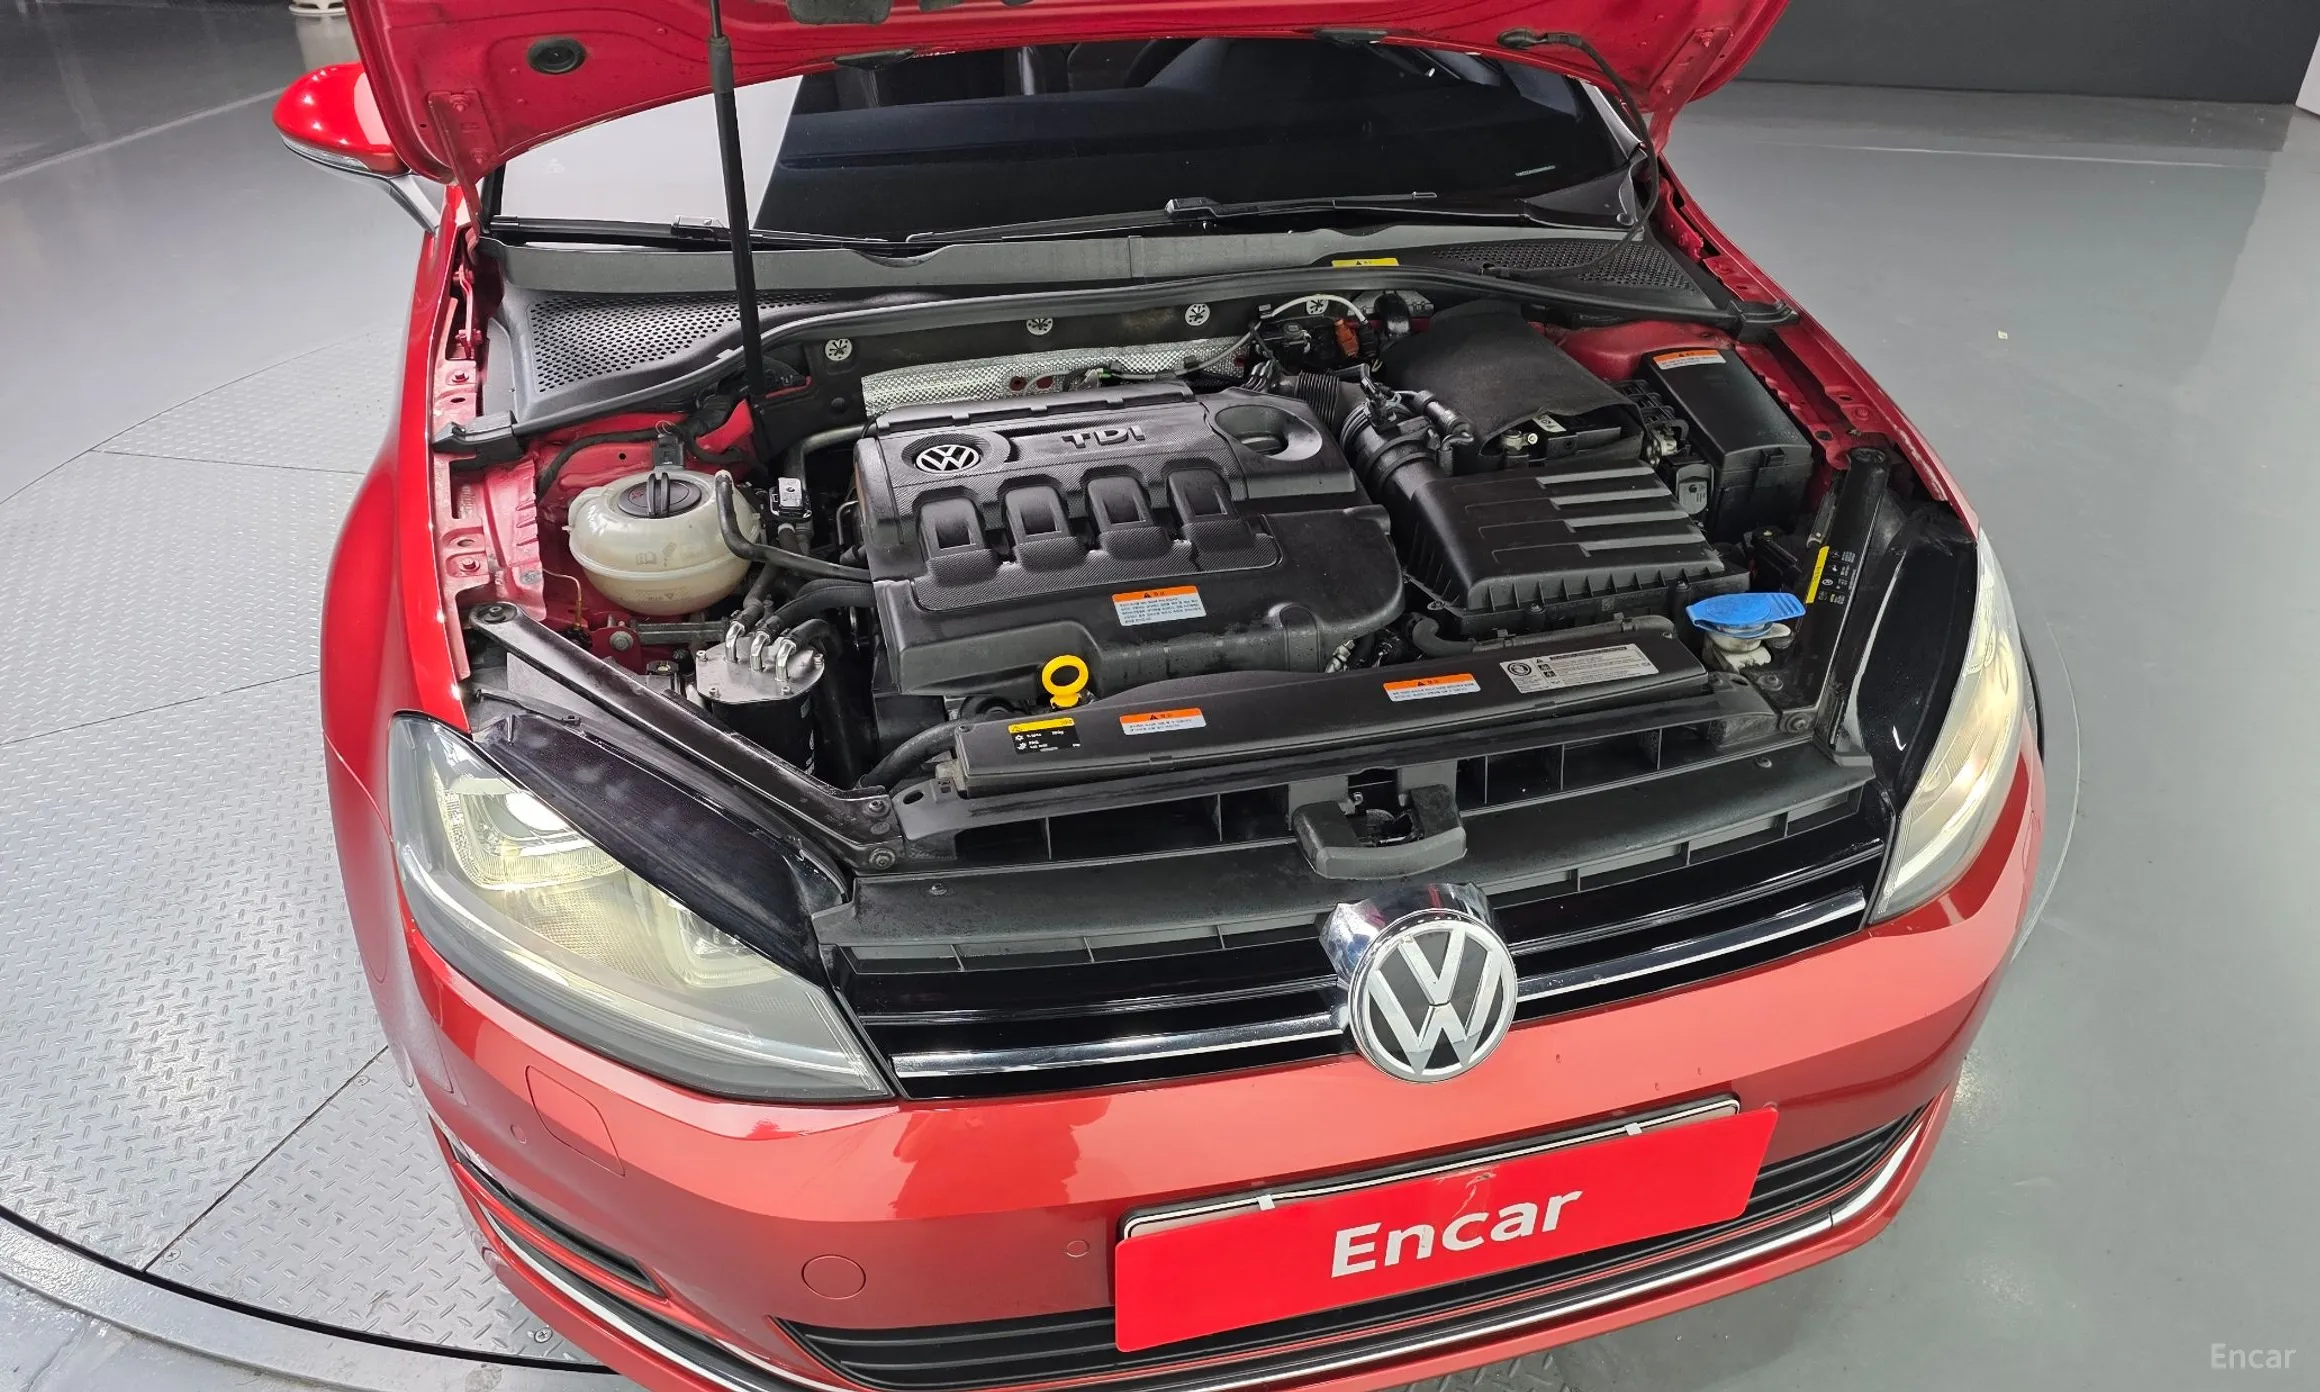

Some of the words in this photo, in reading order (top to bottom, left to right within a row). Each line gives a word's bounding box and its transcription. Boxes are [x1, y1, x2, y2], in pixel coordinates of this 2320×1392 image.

[916, 443, 980, 474] VW
[1061, 424, 1146, 449] TDI
[1358, 916, 1510, 1079] VW
[1331, 1190, 1583, 1278] Encar
